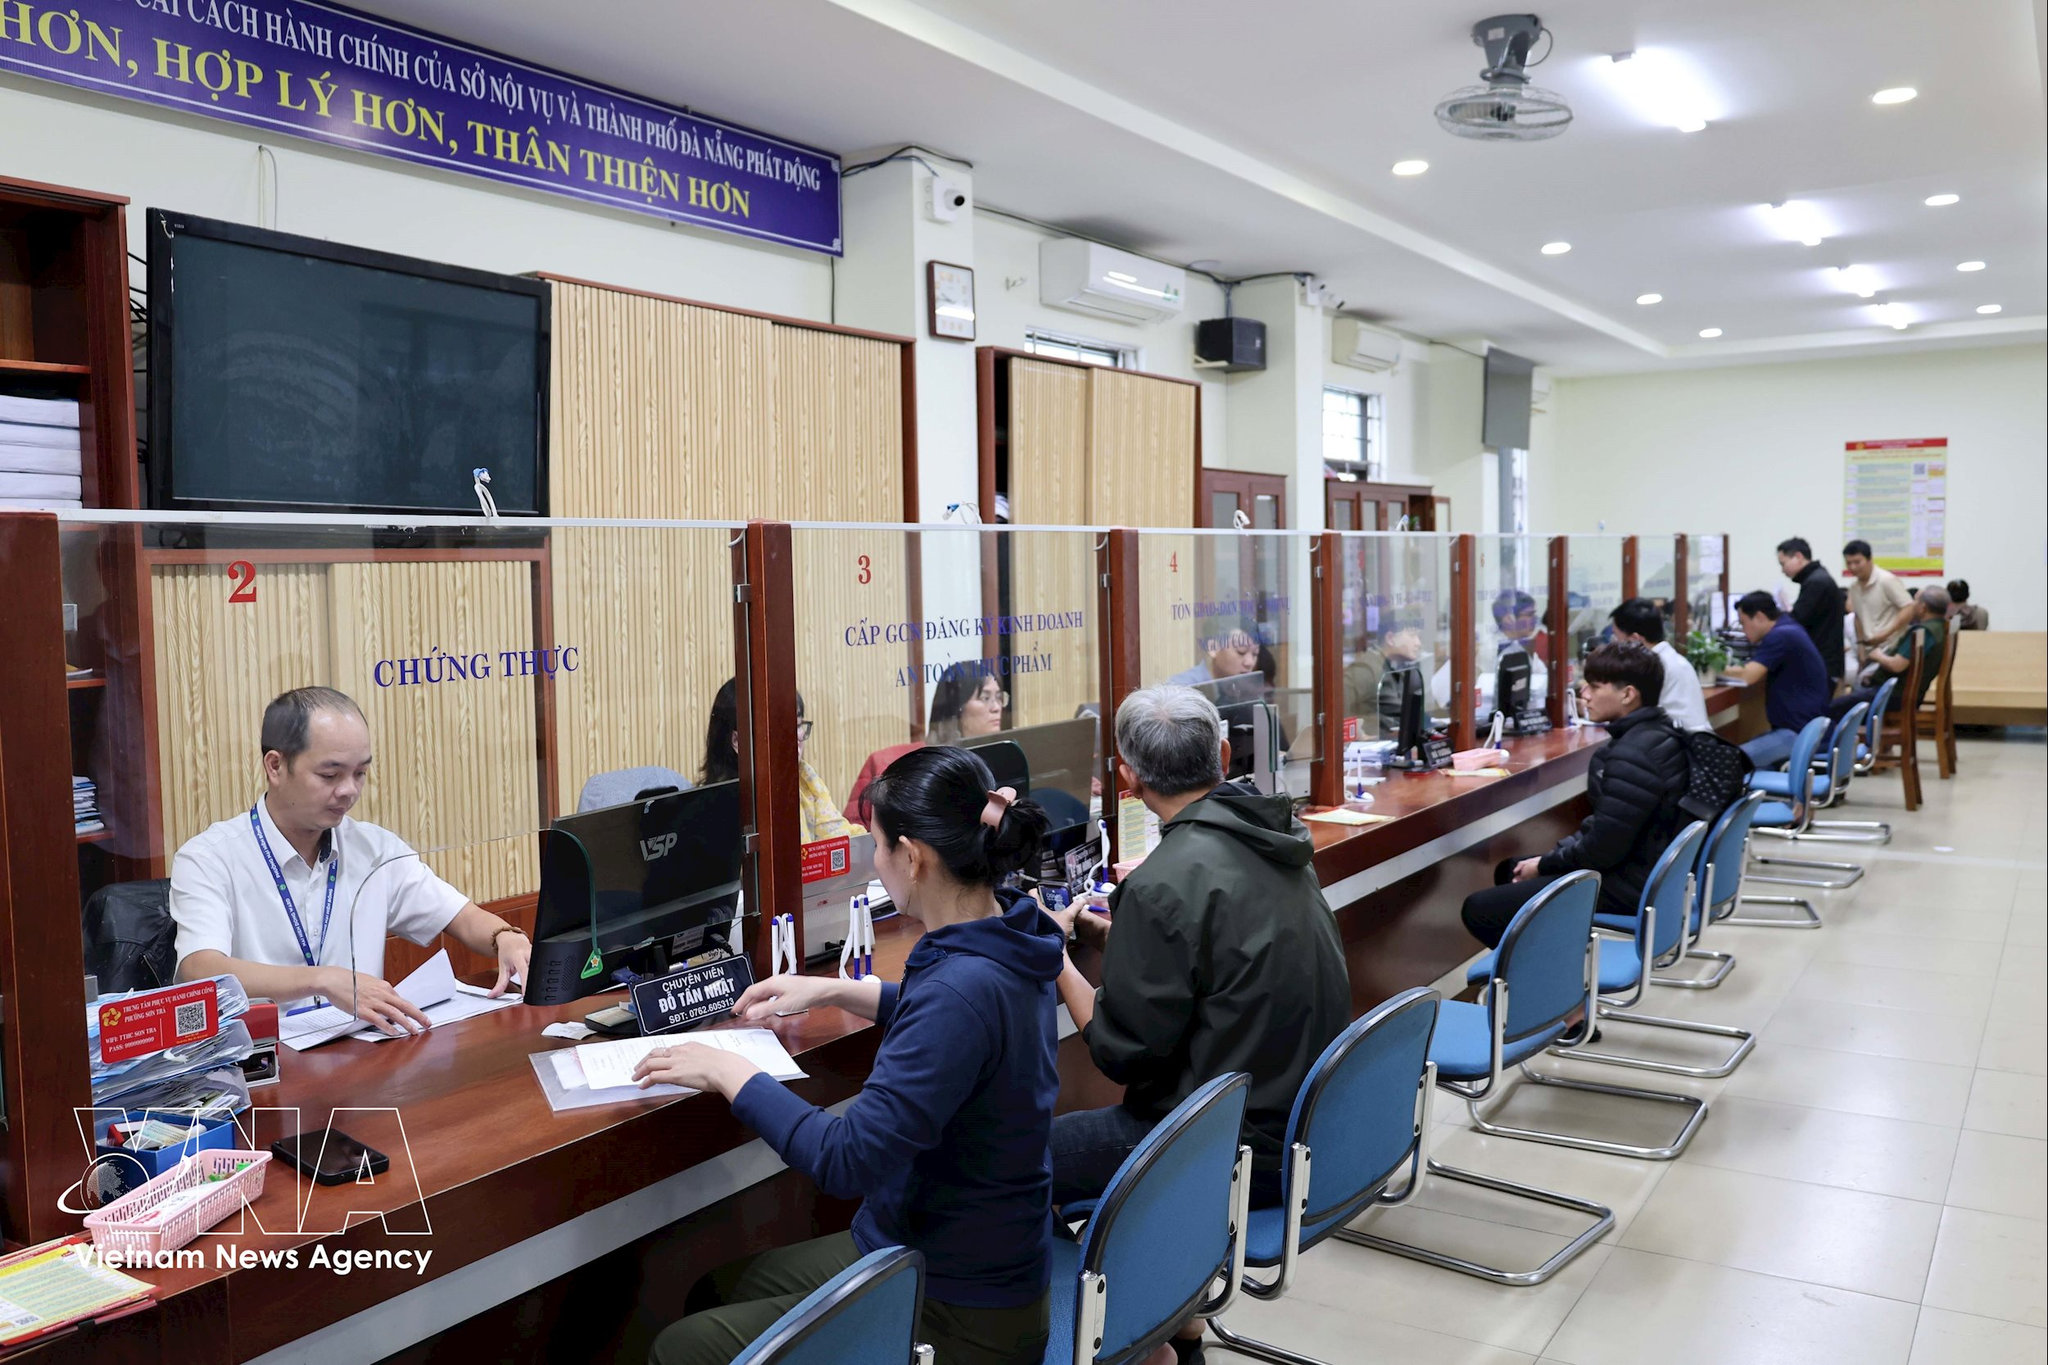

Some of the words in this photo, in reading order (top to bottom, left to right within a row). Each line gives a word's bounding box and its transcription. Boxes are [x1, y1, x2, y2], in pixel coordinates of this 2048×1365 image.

[0, 0, 139, 79] HƠN,
[151, 37, 264, 102] HỢP
[276, 71, 338, 118] LÝ
[351, 88, 459, 156] HƠN,
[467, 119, 571, 176] THÂN
[579, 148, 679, 203] THIỆN
[687, 176, 750, 218] HƠN
[264, 7, 333, 59] HÀNH
[338, 33, 409, 80] CHÍNH
[414, 50, 456, 92] CỦA
[460, 62, 486, 100] SỞ
[489, 72, 524, 115] NỘI
[528, 86, 554, 125] VỤ
[557, 90, 582, 126] VÀ
[584, 102, 643, 143] THÀNH
[645, 117, 678, 152] PHỐ
[680, 126, 701, 160] ĐÀ
[704, 129, 744, 170] NẴNG
[746, 148, 782, 181] PHÁT
[784, 156, 821, 192] ĐỘNG
[857, 554, 872, 585] 3
[1169, 550, 1178, 573] 4
[227, 560, 258, 604] 2
[845, 617, 881, 647] CẤP
[886, 621, 923, 645] GCN
[926, 616, 970, 641] ĐĂNG
[998, 614, 1034, 635] KINH
[1037, 611, 1084, 631] DOANH
[374, 646, 491, 687] CHỨNG
[500, 644, 580, 680] THỰC
[896, 665, 918, 687] AN
[923, 653, 966, 684] TOÀN
[1012, 641, 1053, 674] PHẨM
[640, 832, 678, 861] VSP
[658, 989, 677, 1014] ĐỖ
[678, 985, 704, 1008] TẤN
[704, 978, 736, 1000] NHẬT
[662, 973, 702, 992] CHUYÊN
[702, 966, 725, 980] VIÊN
[669, 1012, 689, 1025] SĐT:
[689, 998, 735, 1018] 0762.605313
